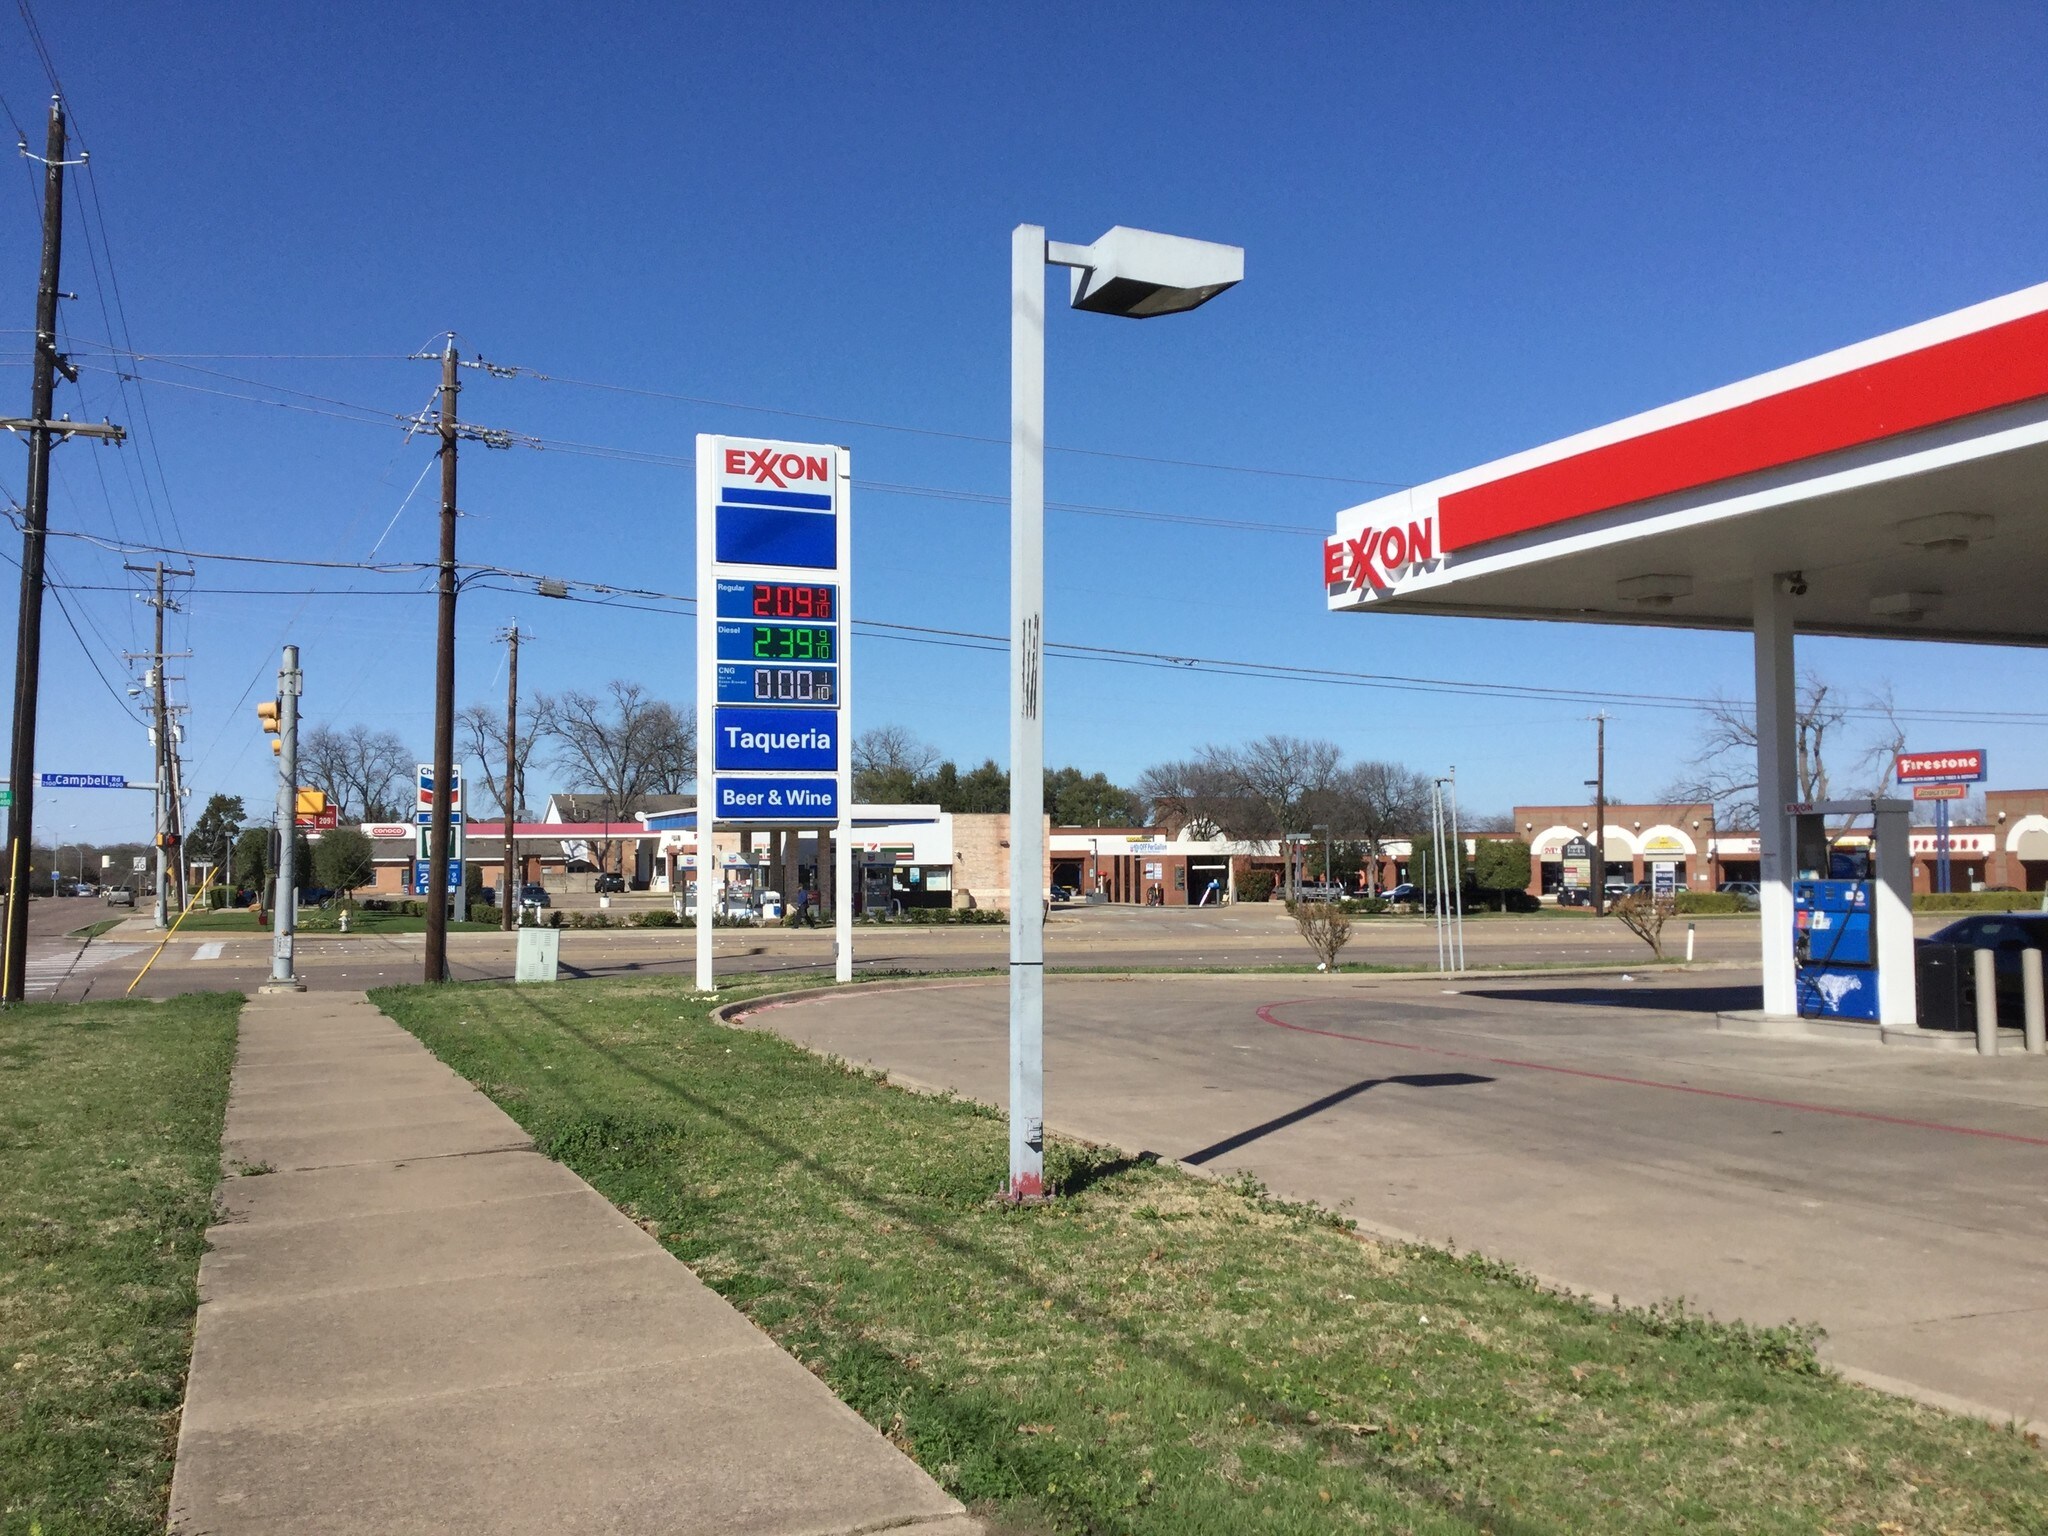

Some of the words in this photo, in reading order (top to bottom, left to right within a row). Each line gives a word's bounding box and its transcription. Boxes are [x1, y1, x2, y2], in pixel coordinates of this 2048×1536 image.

[725, 448, 828, 488] EXXON
[1324, 517, 1432, 589] EXXON
[717, 584, 745, 593] Regular
[754, 585, 813, 617] 2.09
[718, 626, 740, 634] Diesel
[754, 627, 813, 658] 2.39
[755, 669, 813, 700] 0.00
[724, 726, 831, 754] Taqueria
[1900, 757, 1978, 773] Firestone
[55, 775, 109, 787] Campbell
[723, 789, 764, 806] Beer
[768, 789, 782, 806] &
[786, 789, 832, 806] Wine
[1786, 804, 1813, 815] EXXON
